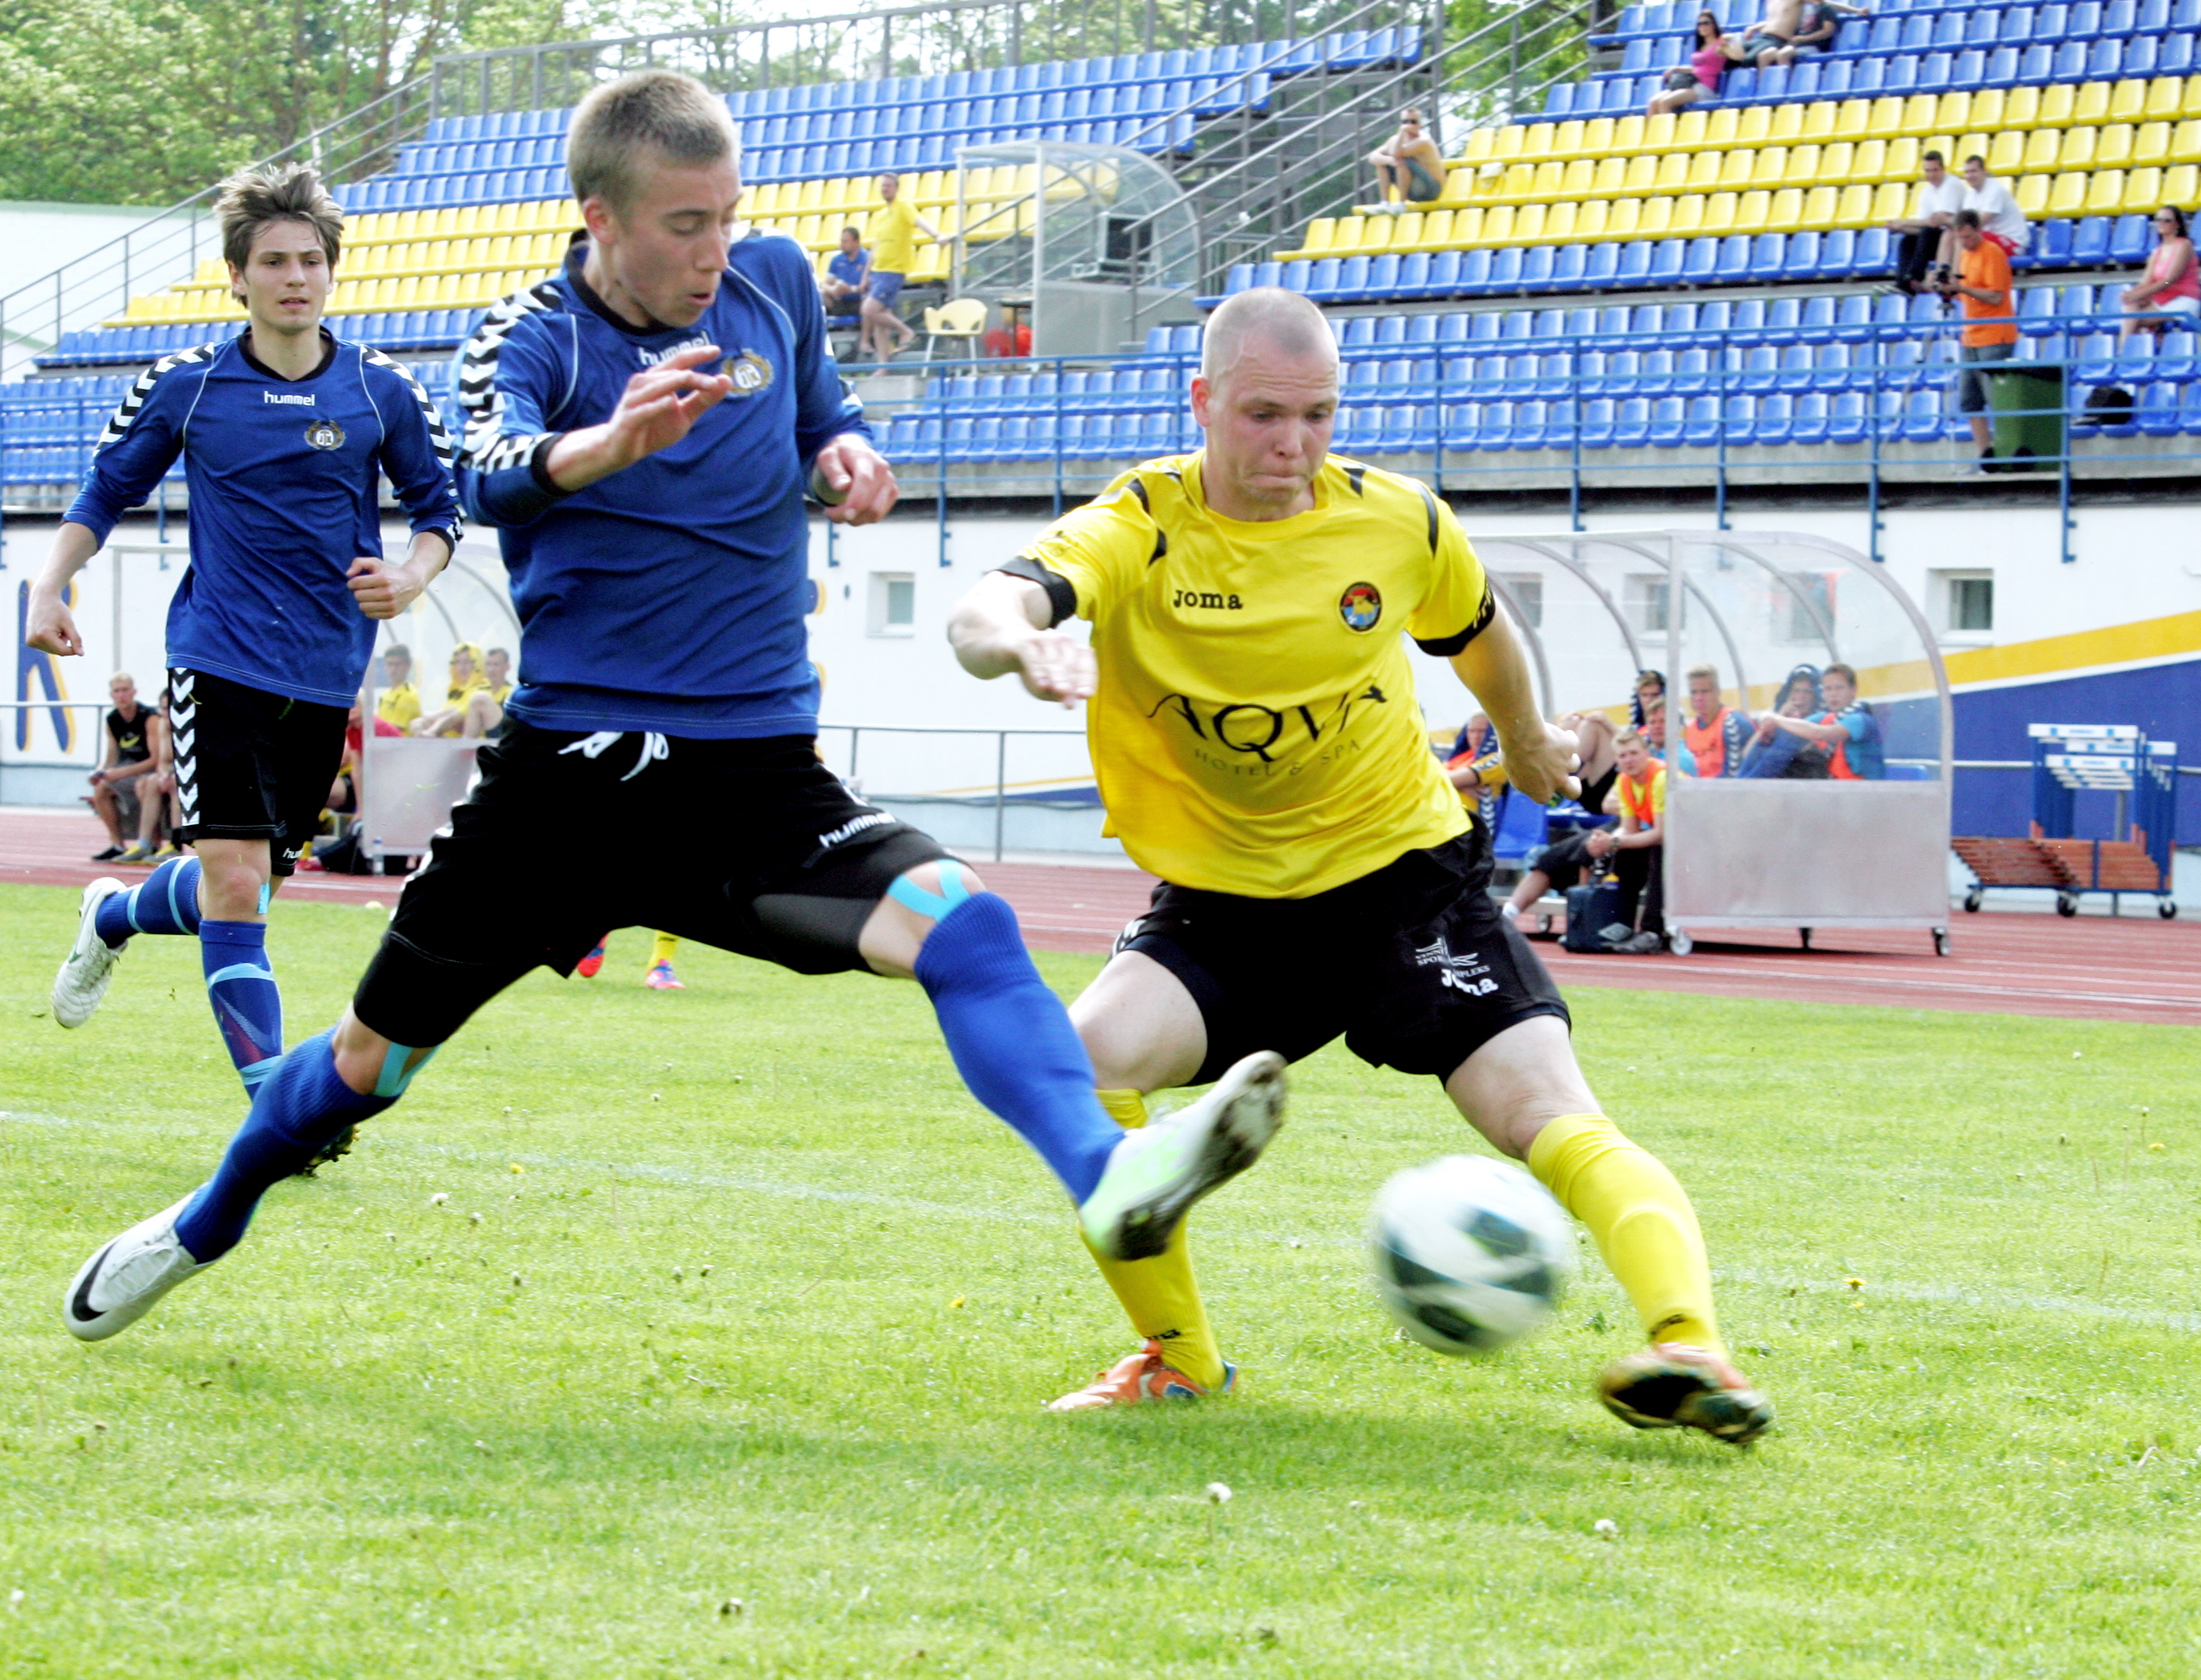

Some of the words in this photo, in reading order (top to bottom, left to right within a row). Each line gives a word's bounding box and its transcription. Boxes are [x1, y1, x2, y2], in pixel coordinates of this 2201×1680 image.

[264, 390, 316, 407] hummel
[1194, 747, 1275, 777] HOTEL
[1320, 738, 1362, 765] SPA
